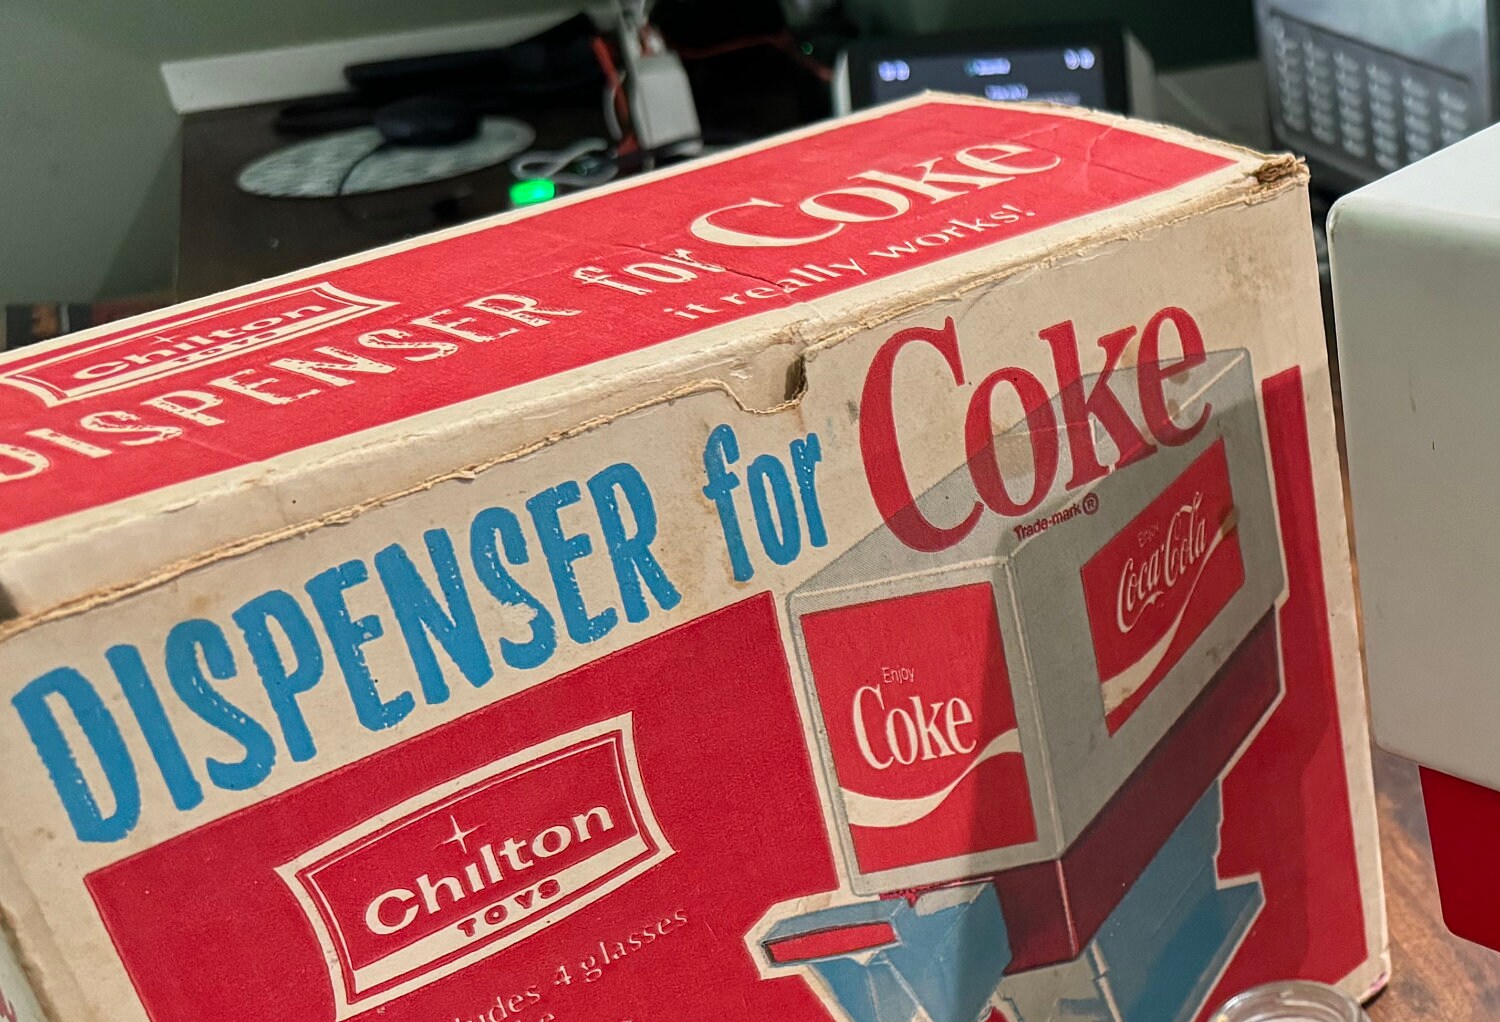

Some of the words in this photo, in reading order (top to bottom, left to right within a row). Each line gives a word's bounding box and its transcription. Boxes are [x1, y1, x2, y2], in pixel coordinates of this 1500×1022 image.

[573, 249, 726, 296] for
[691, 144, 1062, 247] Coke
[664, 307, 721, 321] it
[723, 257, 868, 305] really
[869, 204, 1035, 258] works!
[73, 305, 326, 380] Chilton
[1013, 503, 1082, 541] Trade-mark
[1117, 491, 1207, 633] Coca-Cola
[11, 462, 682, 842] DISPENSER
[703, 423, 828, 582] for
[859, 306, 1212, 553] Coke
[881, 667, 915, 684] Enjoy
[853, 684, 976, 770] Coke
[365, 806, 614, 935] Chilton
[457, 879, 561, 938] TOYS
[553, 964, 572, 986] 4
[580, 908, 689, 983] glasses
